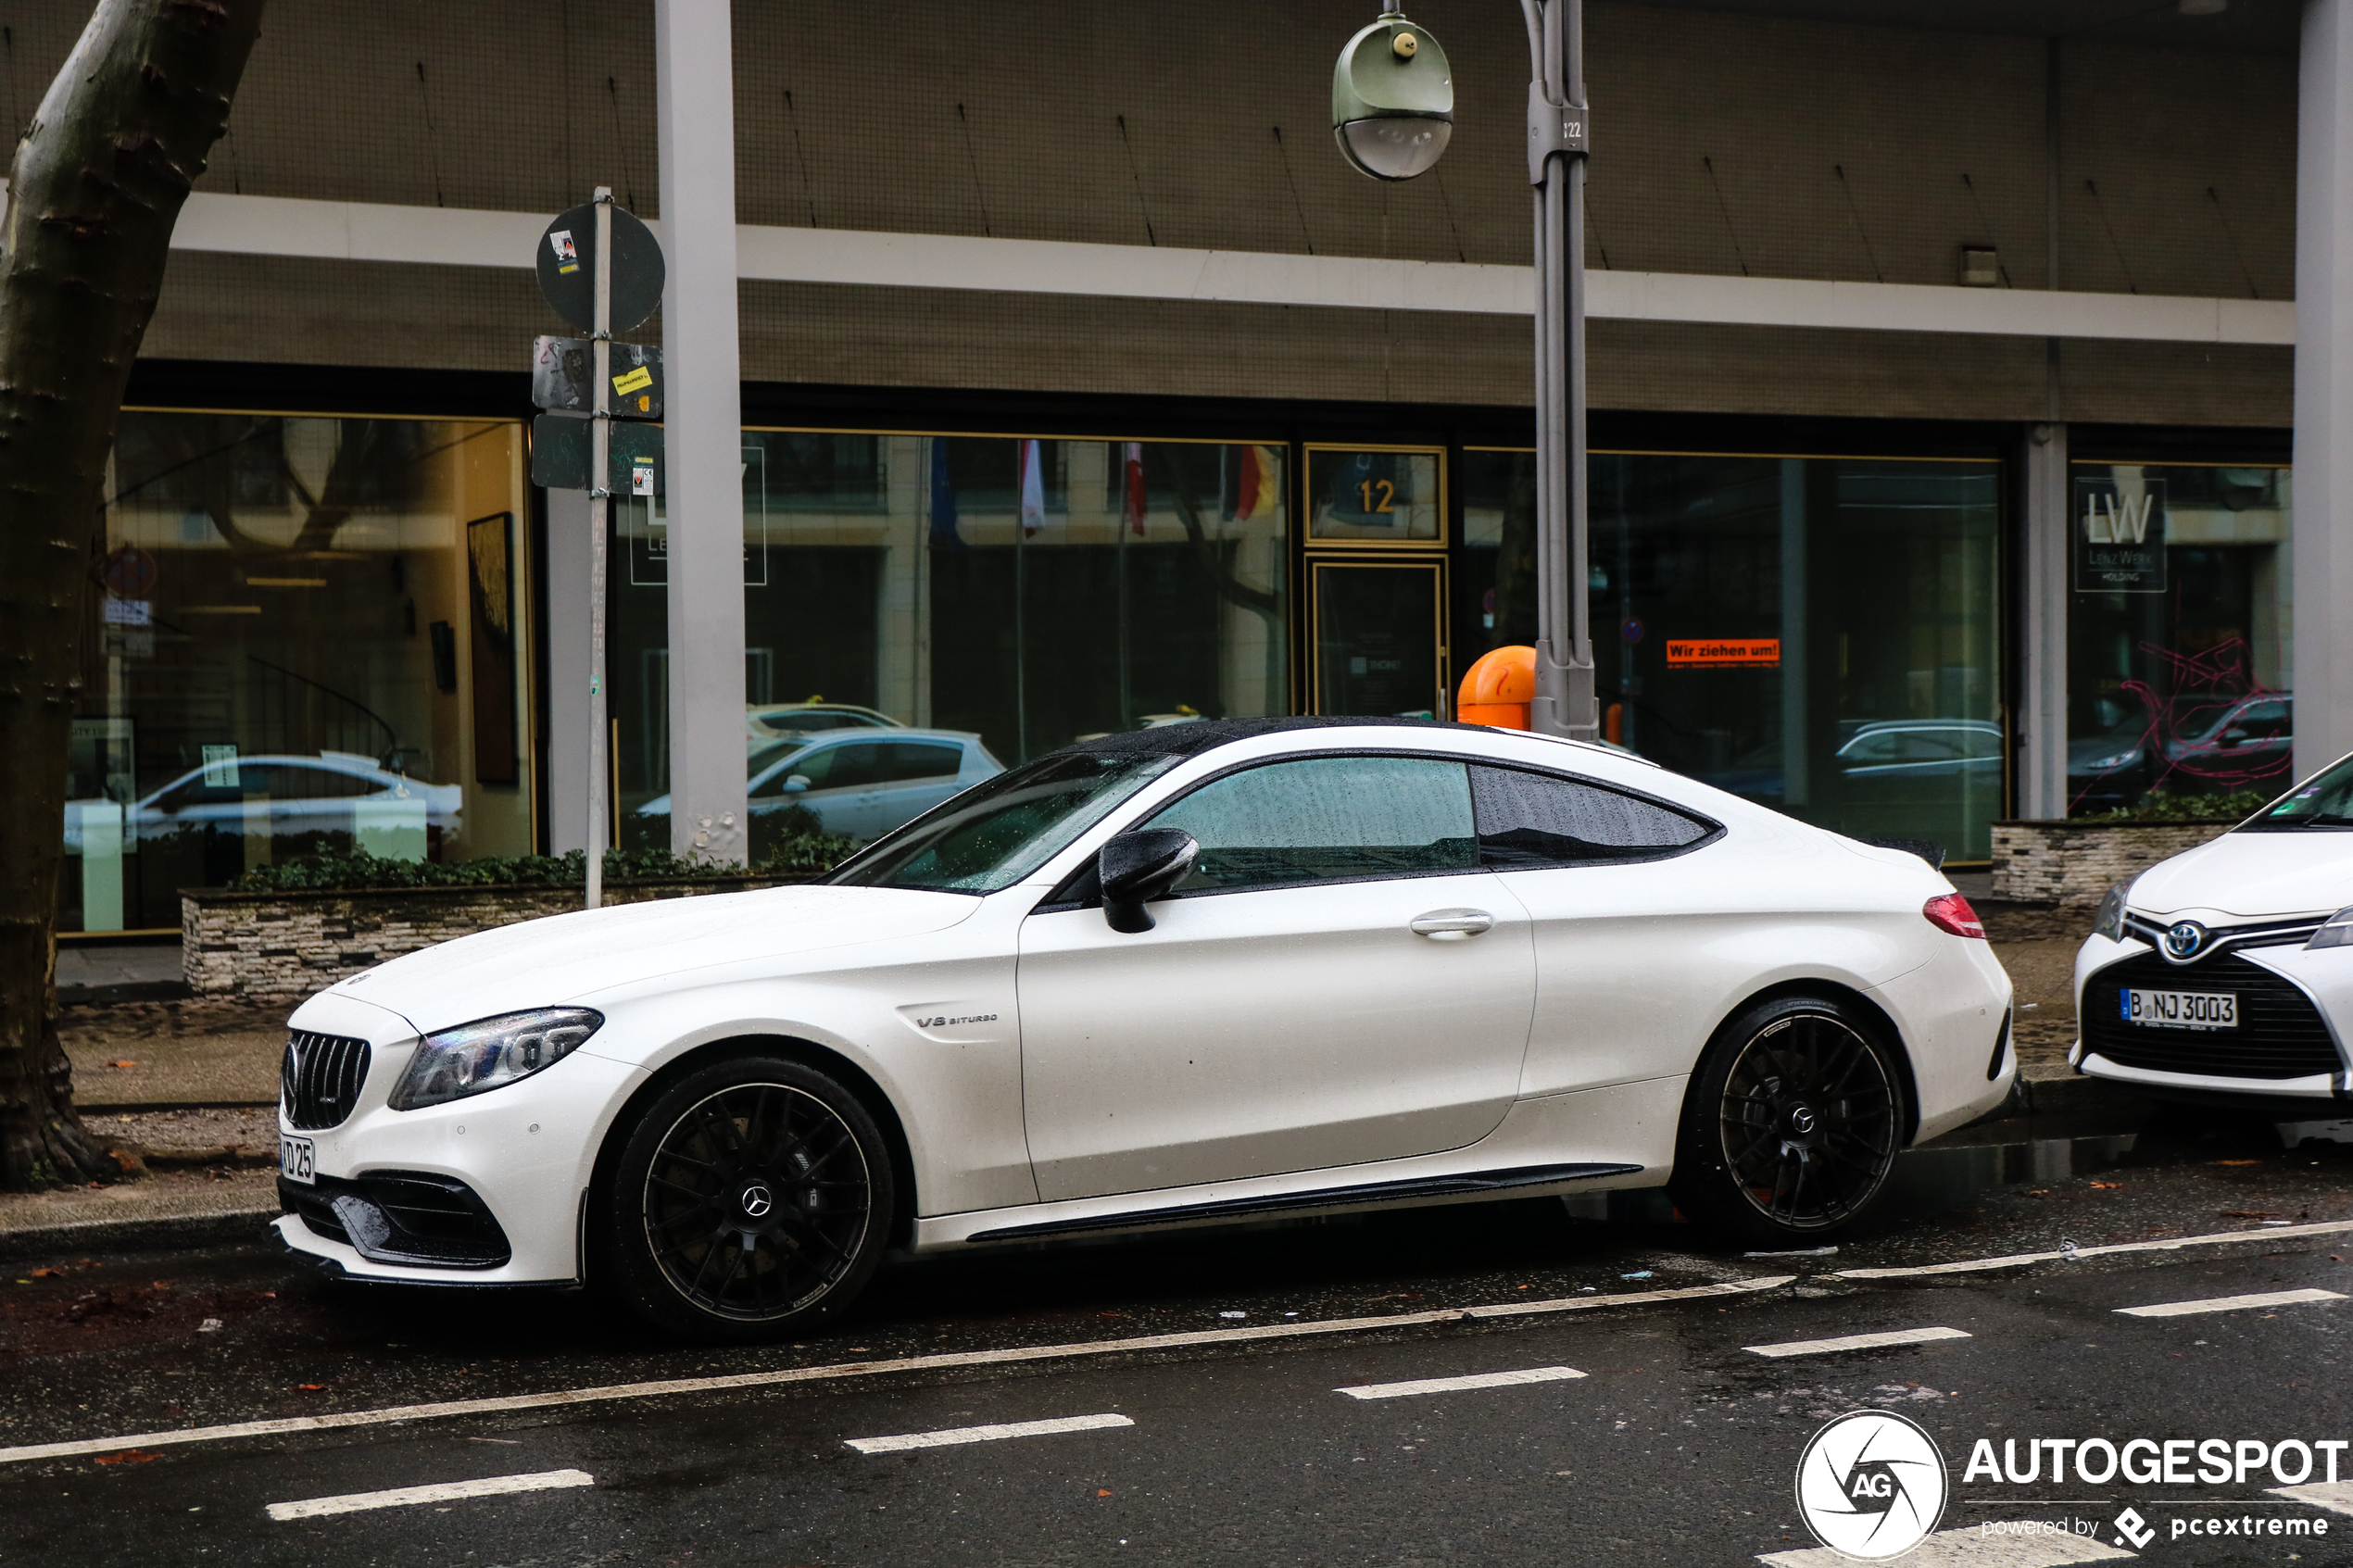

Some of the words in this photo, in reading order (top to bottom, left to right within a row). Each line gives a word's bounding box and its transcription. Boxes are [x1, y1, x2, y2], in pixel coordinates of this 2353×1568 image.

[1563, 121, 1582, 139] 122
[1360, 479, 1395, 513] 12
[2088, 493, 2154, 544] LW
[2101, 572, 2141, 583] HOLDING
[1669, 645, 1694, 657] Wir
[1698, 644, 1746, 657] ziehen
[1751, 643, 1778, 656] um!
[2131, 992, 2142, 1017] B
[2154, 993, 2178, 1020] NJ
[2183, 995, 2233, 1022] 3003
[916, 1016, 946, 1028] V8
[949, 1014, 998, 1025] BITURBO
[296, 1143, 311, 1179] 25
